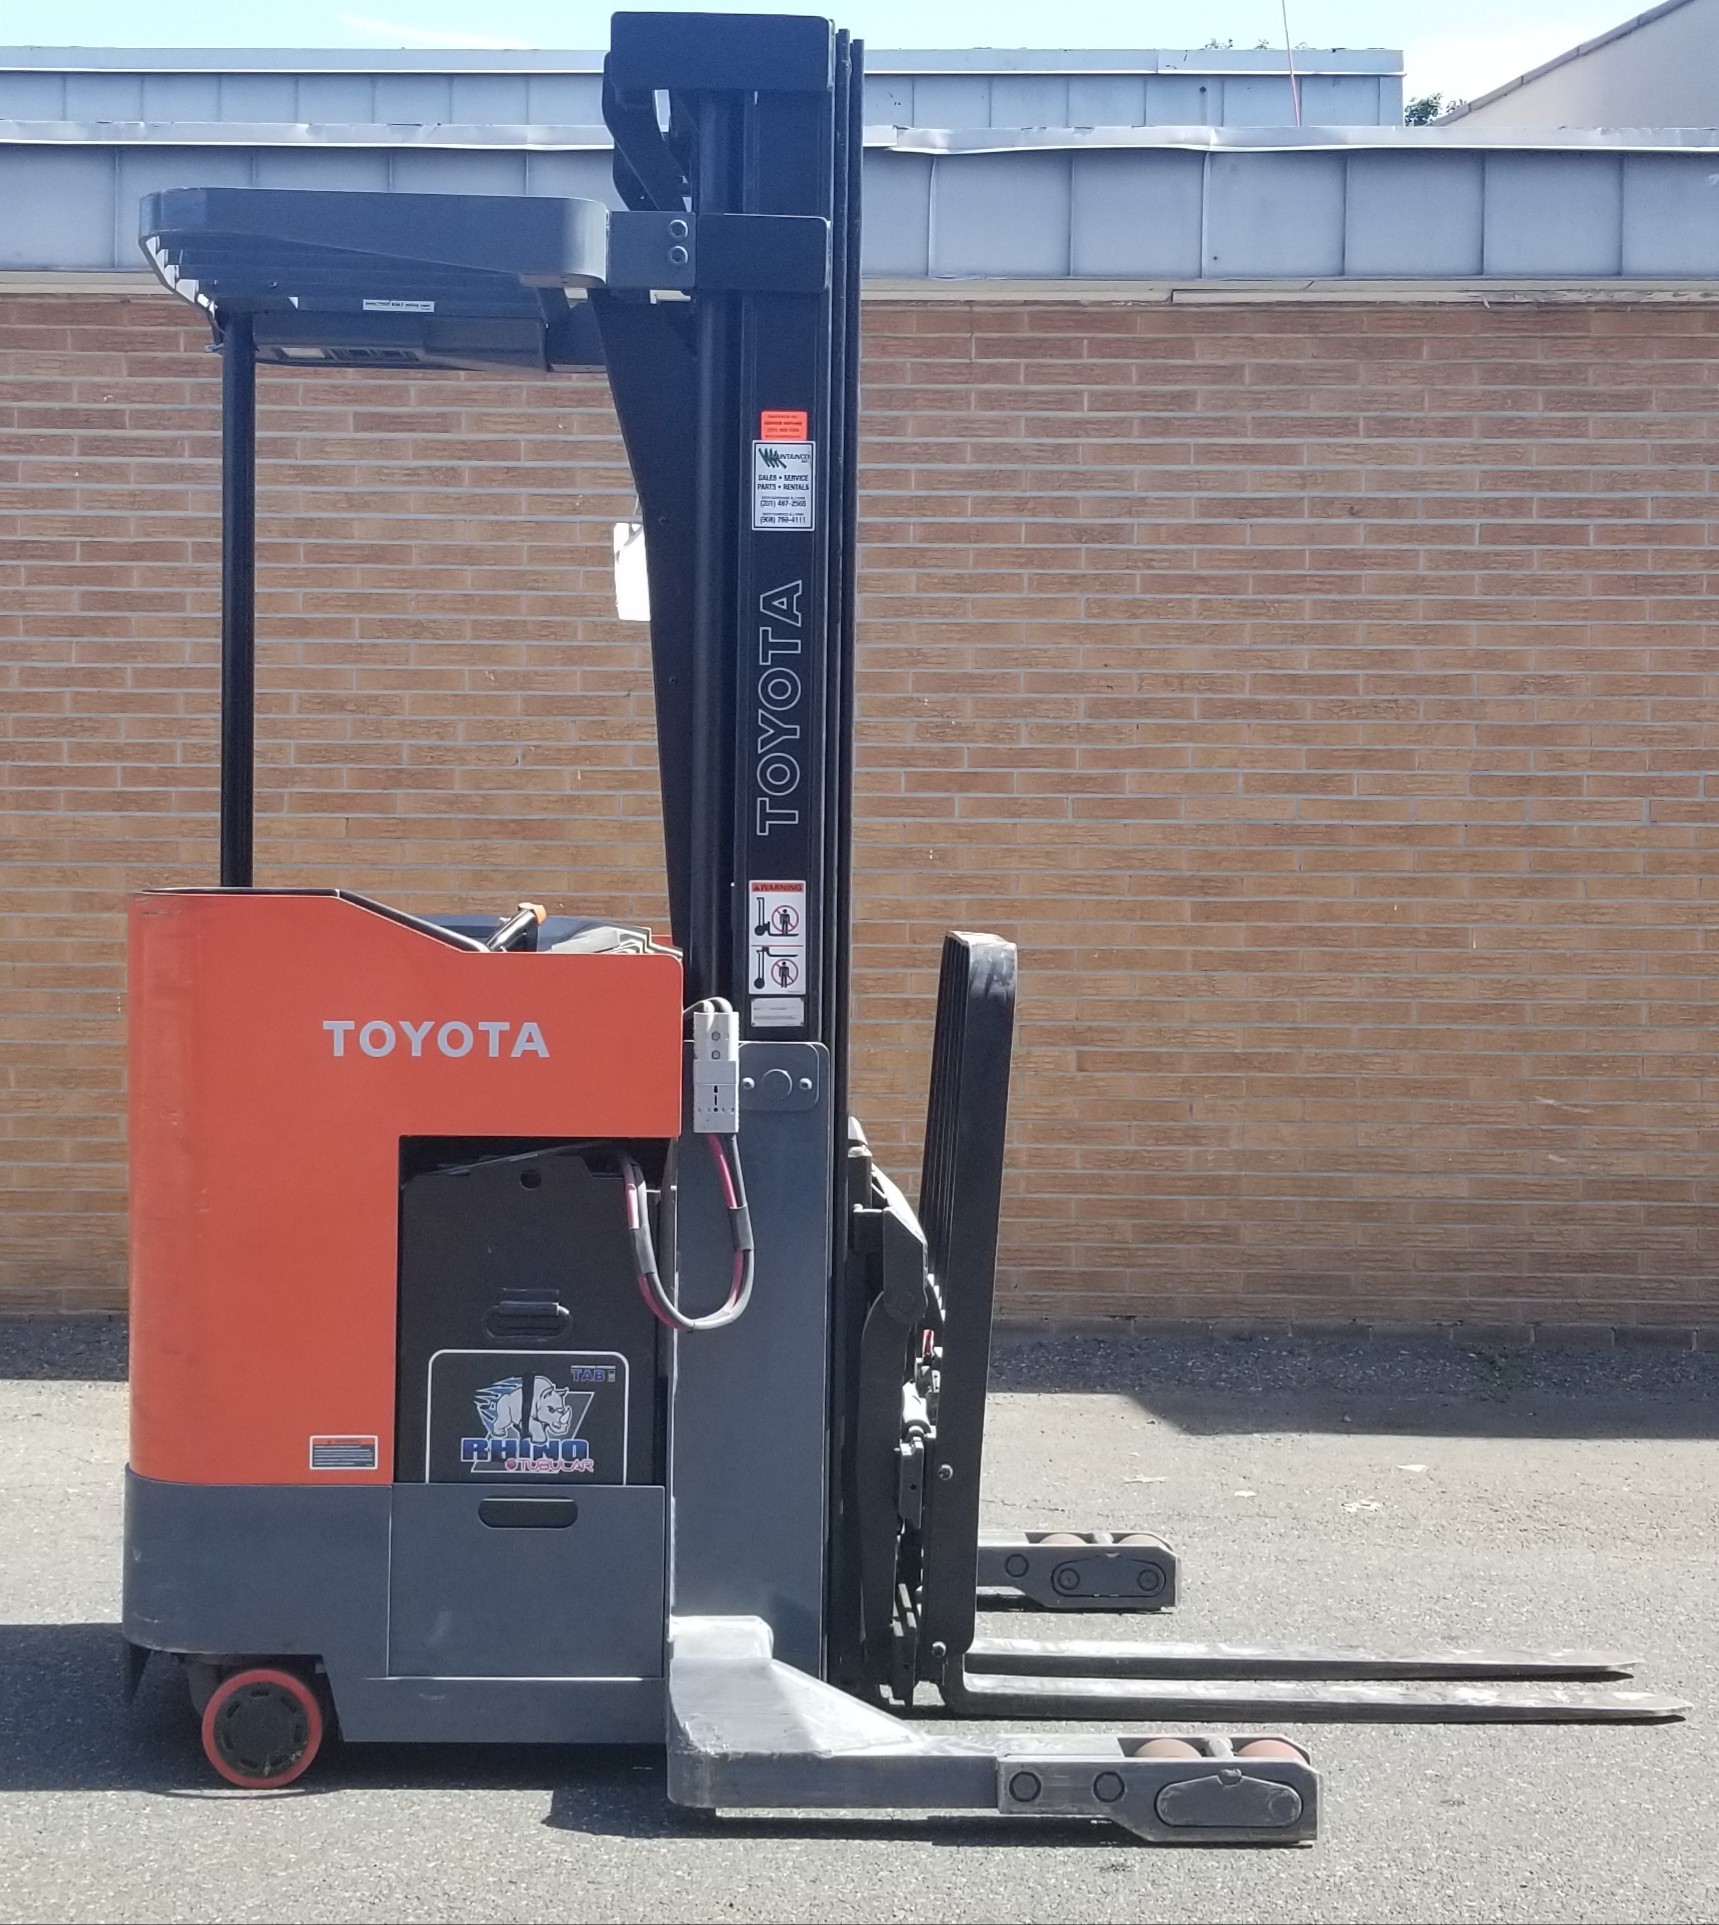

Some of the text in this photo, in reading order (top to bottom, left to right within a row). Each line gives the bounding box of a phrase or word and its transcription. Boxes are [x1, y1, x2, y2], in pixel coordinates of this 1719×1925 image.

[758, 474, 809, 482] SALES SERVICE
[757, 483, 777, 491] PARTS
[756, 579, 802, 836] TOYOTA
[322, 1020, 551, 1058] TOYOTA
[570, 1368, 606, 1382] TAB
[461, 1437, 590, 1463] RHINO
[515, 1458, 595, 1473] TUBULAR
